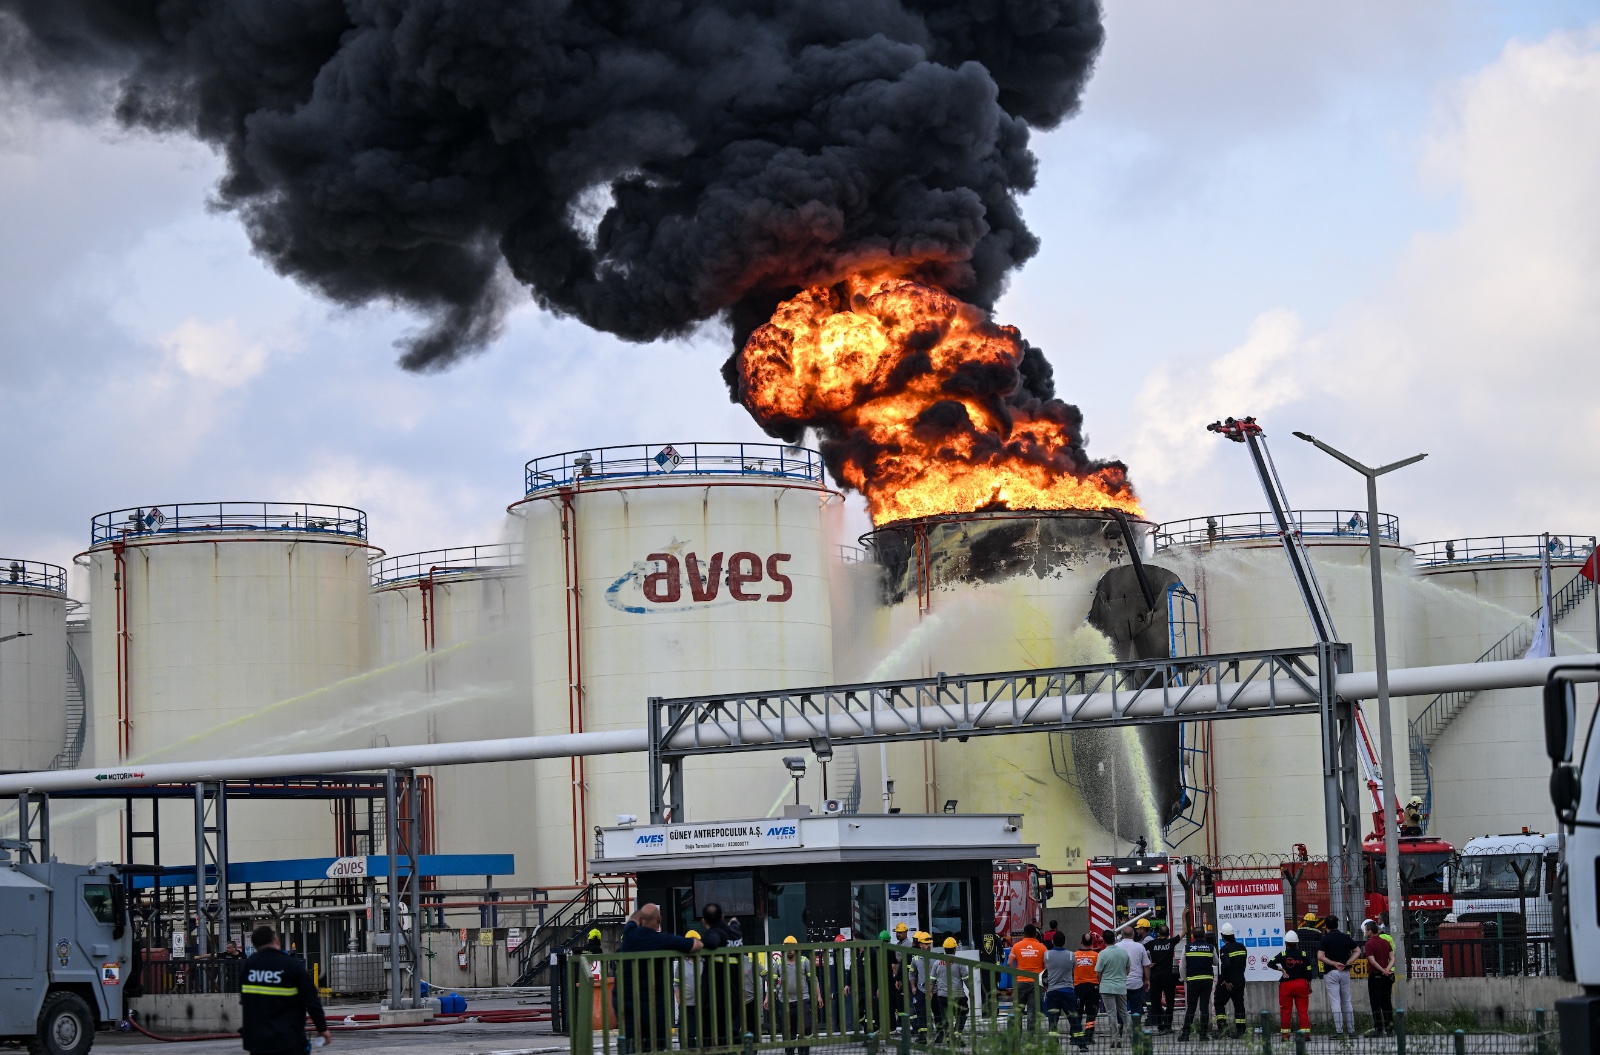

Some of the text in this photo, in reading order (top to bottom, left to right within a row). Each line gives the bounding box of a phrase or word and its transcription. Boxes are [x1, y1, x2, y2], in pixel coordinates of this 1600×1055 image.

[666, 447, 672, 456] 2
[673, 455, 679, 464] 0
[158, 515, 164, 524] 0
[643, 552, 792, 603] aves
[669, 826, 763, 841] GÜNEY ANTREPOCULUK A.Ş.
[766, 826, 796, 837] AVES
[636, 834, 664, 844] AVES
[337, 861, 364, 875] aves
[1217, 884, 1239, 894] DİKKAT
[1244, 883, 1279, 893] ATTENTION
[1253, 911, 1282, 919] INSTRUCTIONS
[1153, 943, 1170, 951] AFAD
[248, 969, 284, 984] aves
